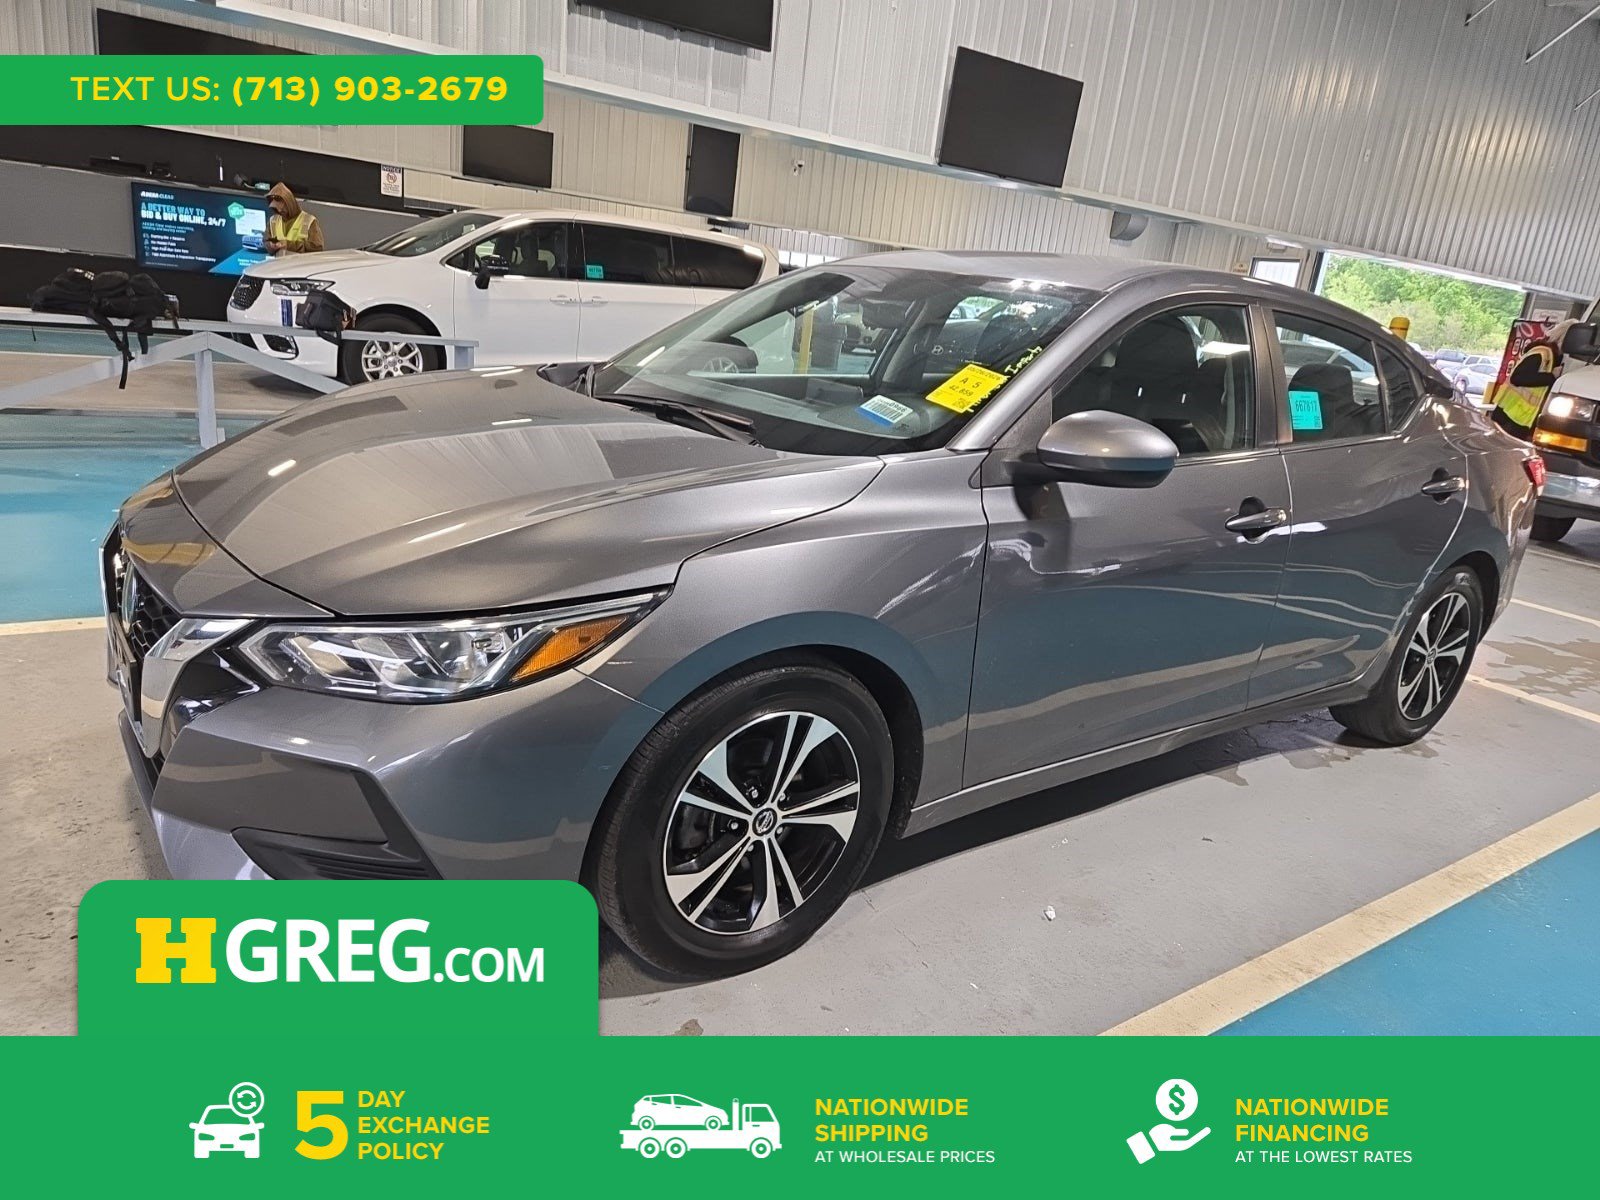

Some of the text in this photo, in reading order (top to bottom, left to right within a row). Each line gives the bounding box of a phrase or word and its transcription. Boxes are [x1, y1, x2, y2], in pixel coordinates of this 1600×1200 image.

[141, 202, 206, 217] A BETTER WAY TO
[141, 210, 227, 228] BID & BUY ONLINE, 24/7
[959, 377, 983, 389] A 5
